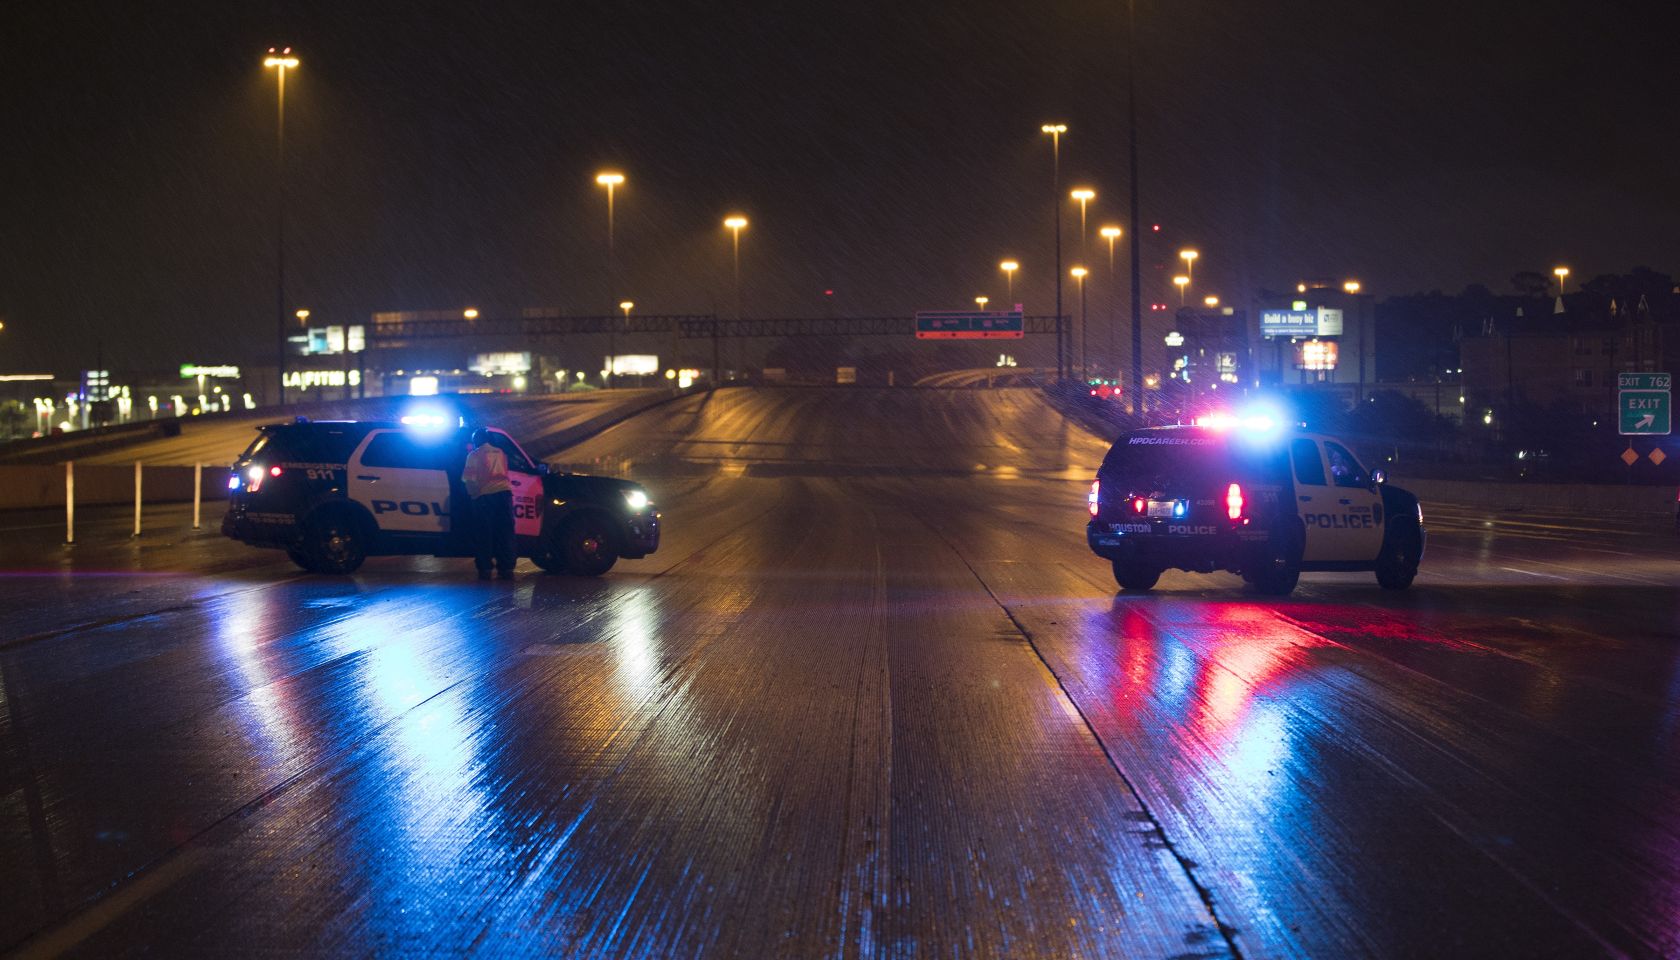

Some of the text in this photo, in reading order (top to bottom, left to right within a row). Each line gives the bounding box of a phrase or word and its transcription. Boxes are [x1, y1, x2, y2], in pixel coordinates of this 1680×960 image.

[282, 371, 301, 387] LA
[1619, 376, 1670, 387] EXIT 762
[1629, 399, 1661, 409] EXIT
[306, 469, 335, 480] 911
[1304, 513, 1373, 529] POLICE
[1108, 523, 1216, 535] HOUSTON POLICE
